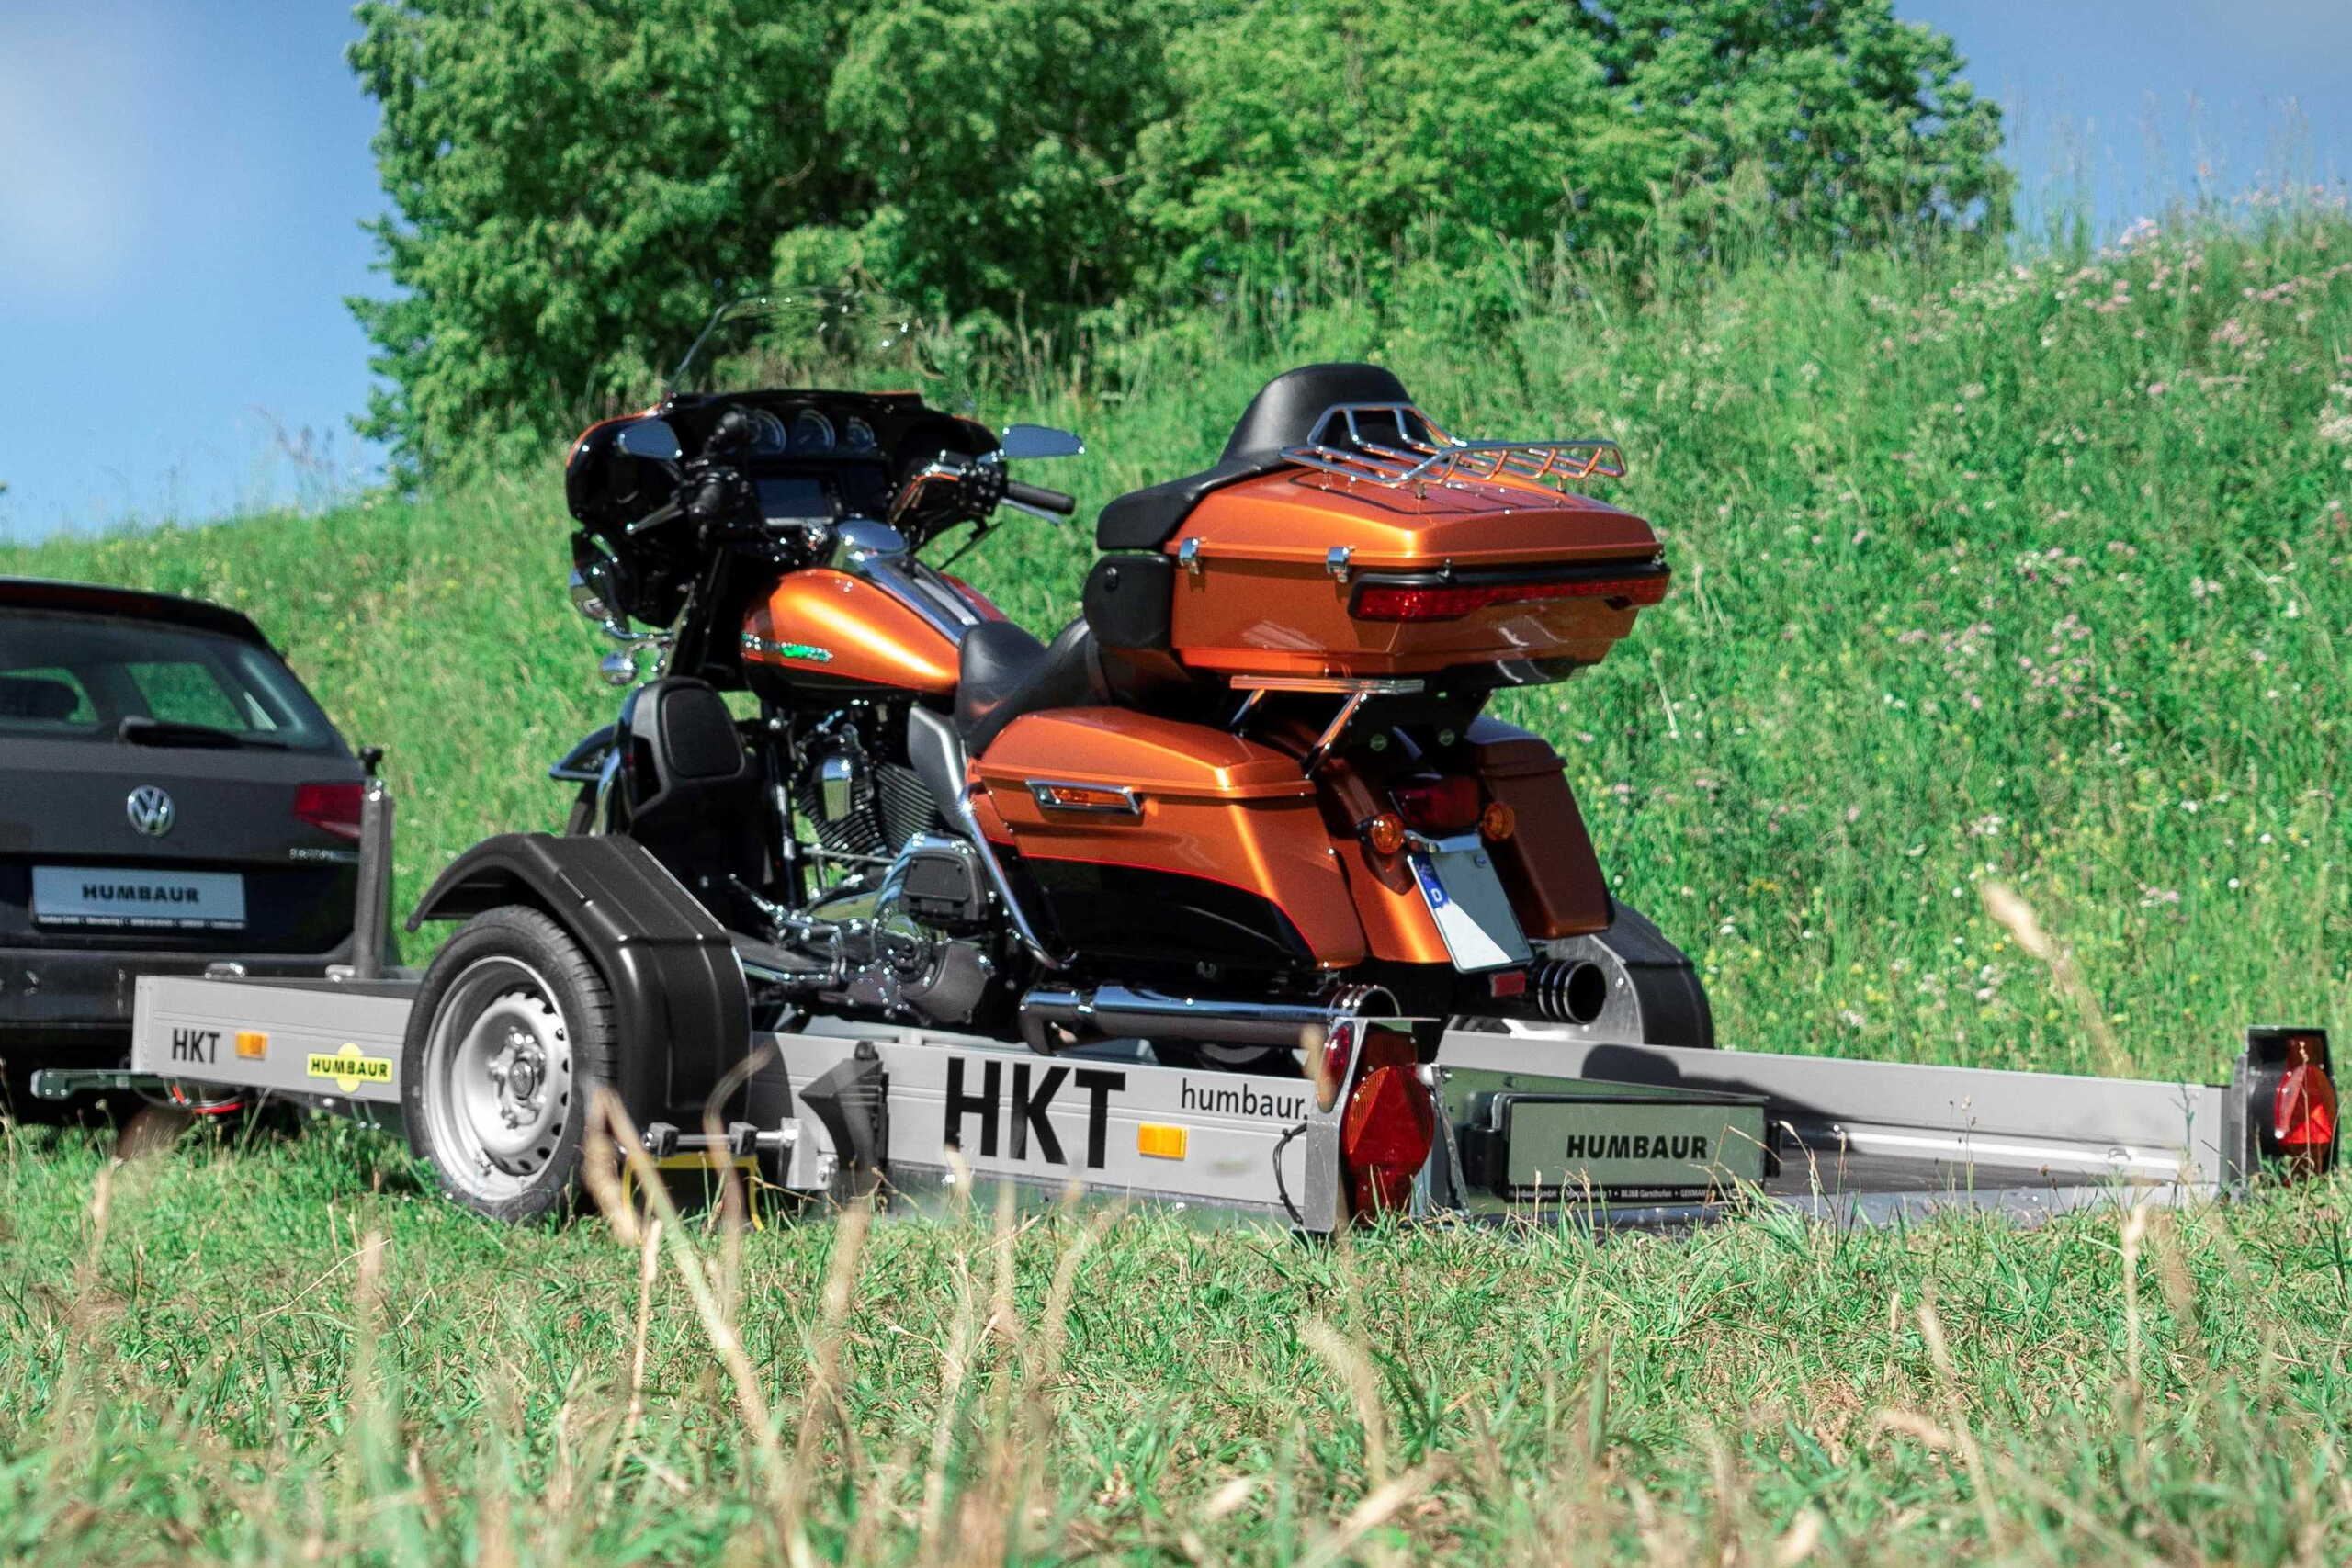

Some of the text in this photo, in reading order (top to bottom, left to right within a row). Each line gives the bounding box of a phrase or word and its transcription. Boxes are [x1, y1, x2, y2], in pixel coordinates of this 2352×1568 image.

[82, 884, 199, 904] HUMBAUR
[172, 1028, 220, 1064] HKT
[311, 1057, 389, 1077] HUMBAUR
[944, 1056, 1126, 1169] HKT
[1566, 1134, 1708, 1159] HUMBAUR
